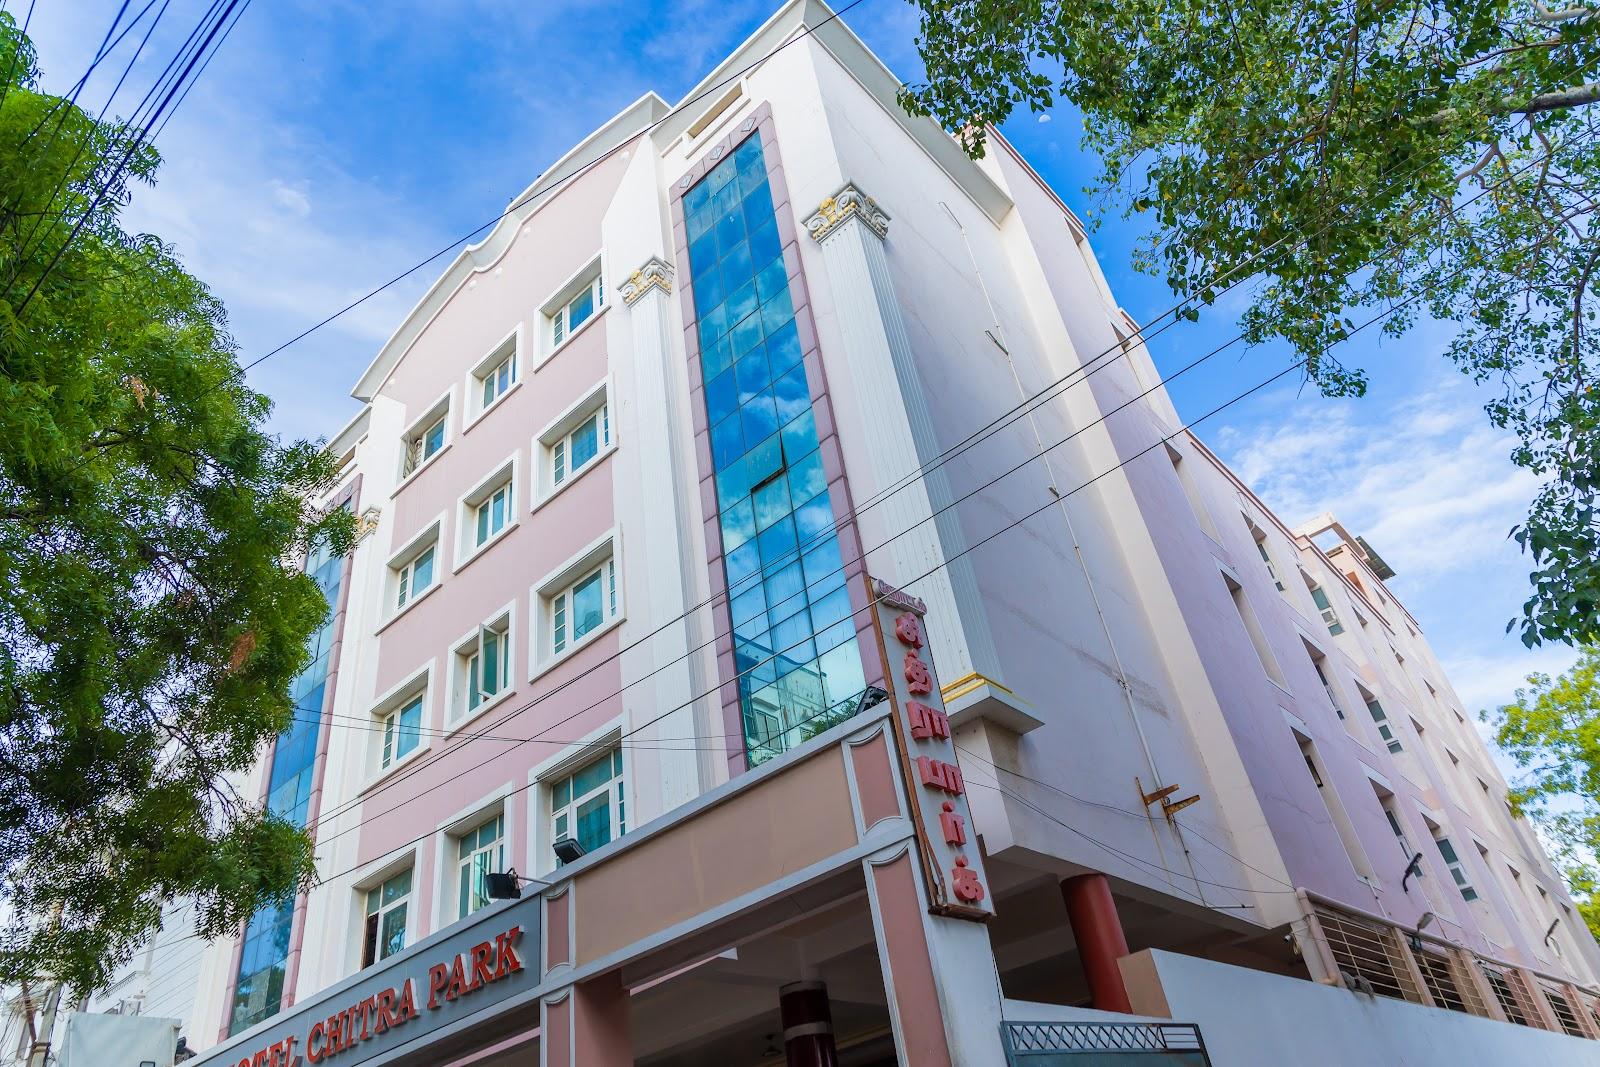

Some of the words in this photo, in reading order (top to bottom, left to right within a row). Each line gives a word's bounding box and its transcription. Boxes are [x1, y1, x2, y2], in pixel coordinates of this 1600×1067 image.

[229, 1035, 302, 1067] TEL
[307, 977, 418, 1065] CHITRA
[427, 926, 525, 1010] PARK
